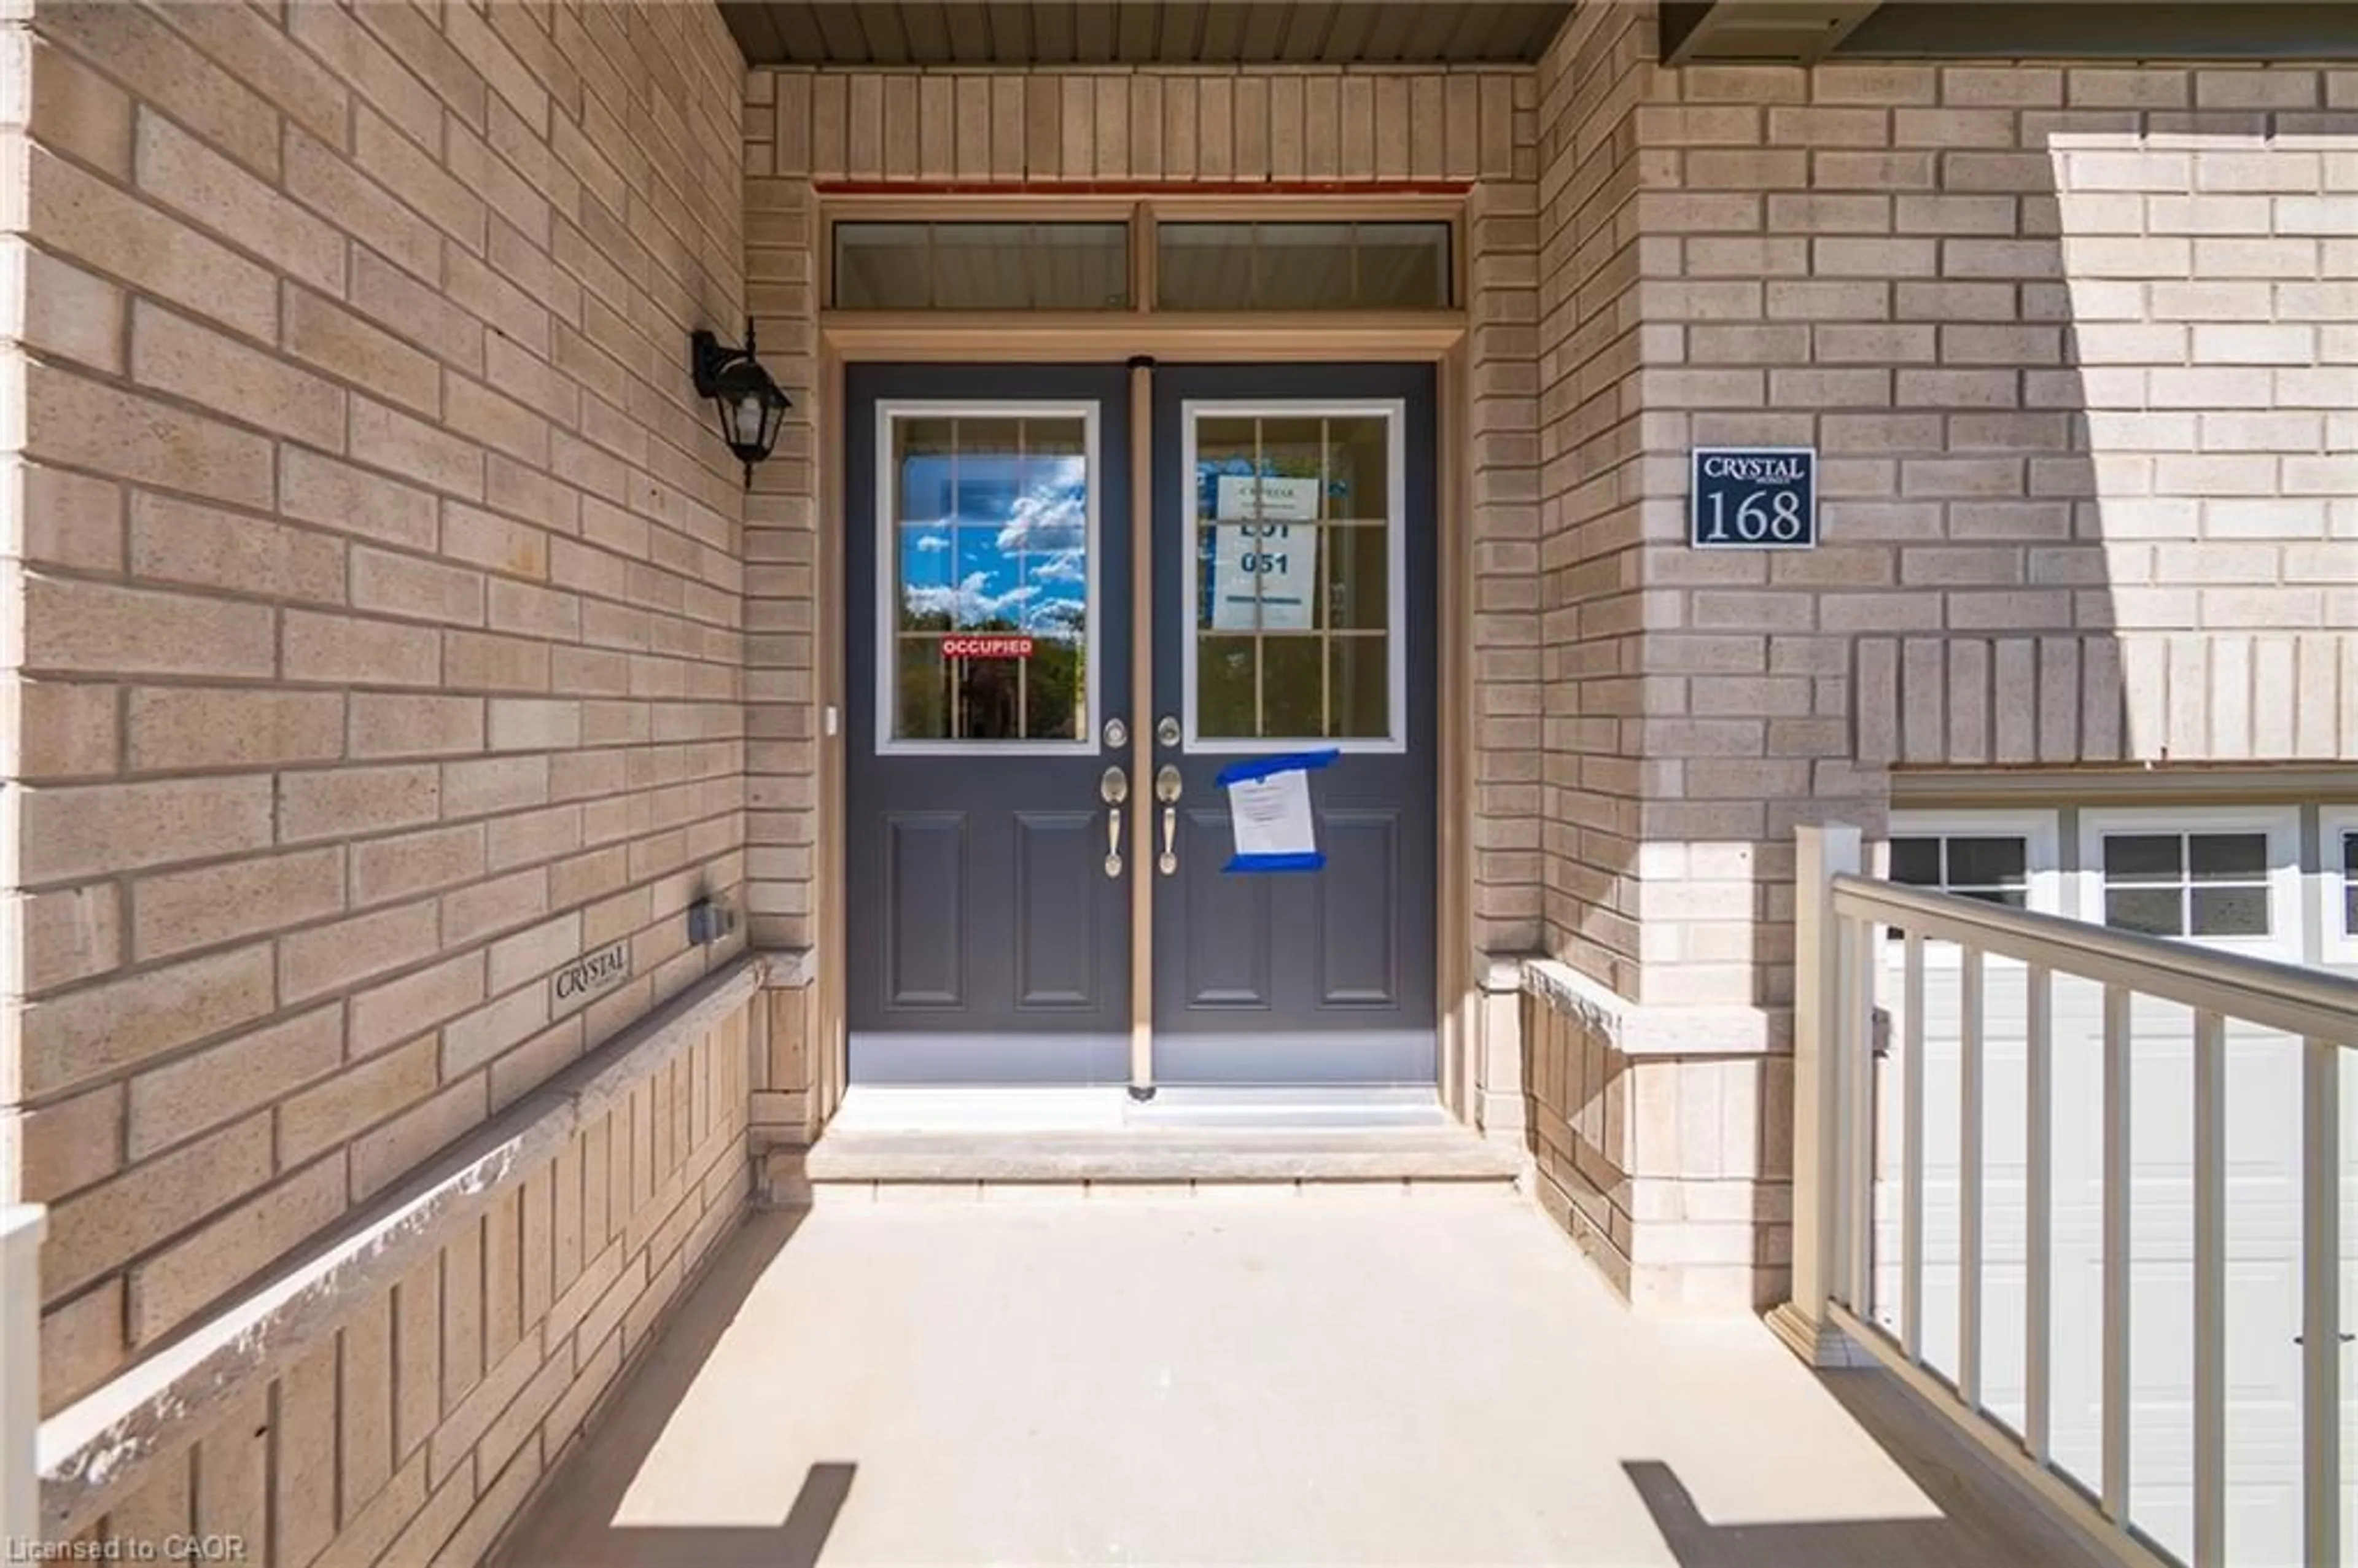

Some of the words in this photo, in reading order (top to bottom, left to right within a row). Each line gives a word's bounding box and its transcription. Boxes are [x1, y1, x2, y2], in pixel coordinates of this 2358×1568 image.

[1704, 456, 1805, 480] CRYSTAL
[1706, 490, 1802, 540] 168
[1241, 553, 1288, 574] 051
[944, 640, 1032, 654] OCCUPIED
